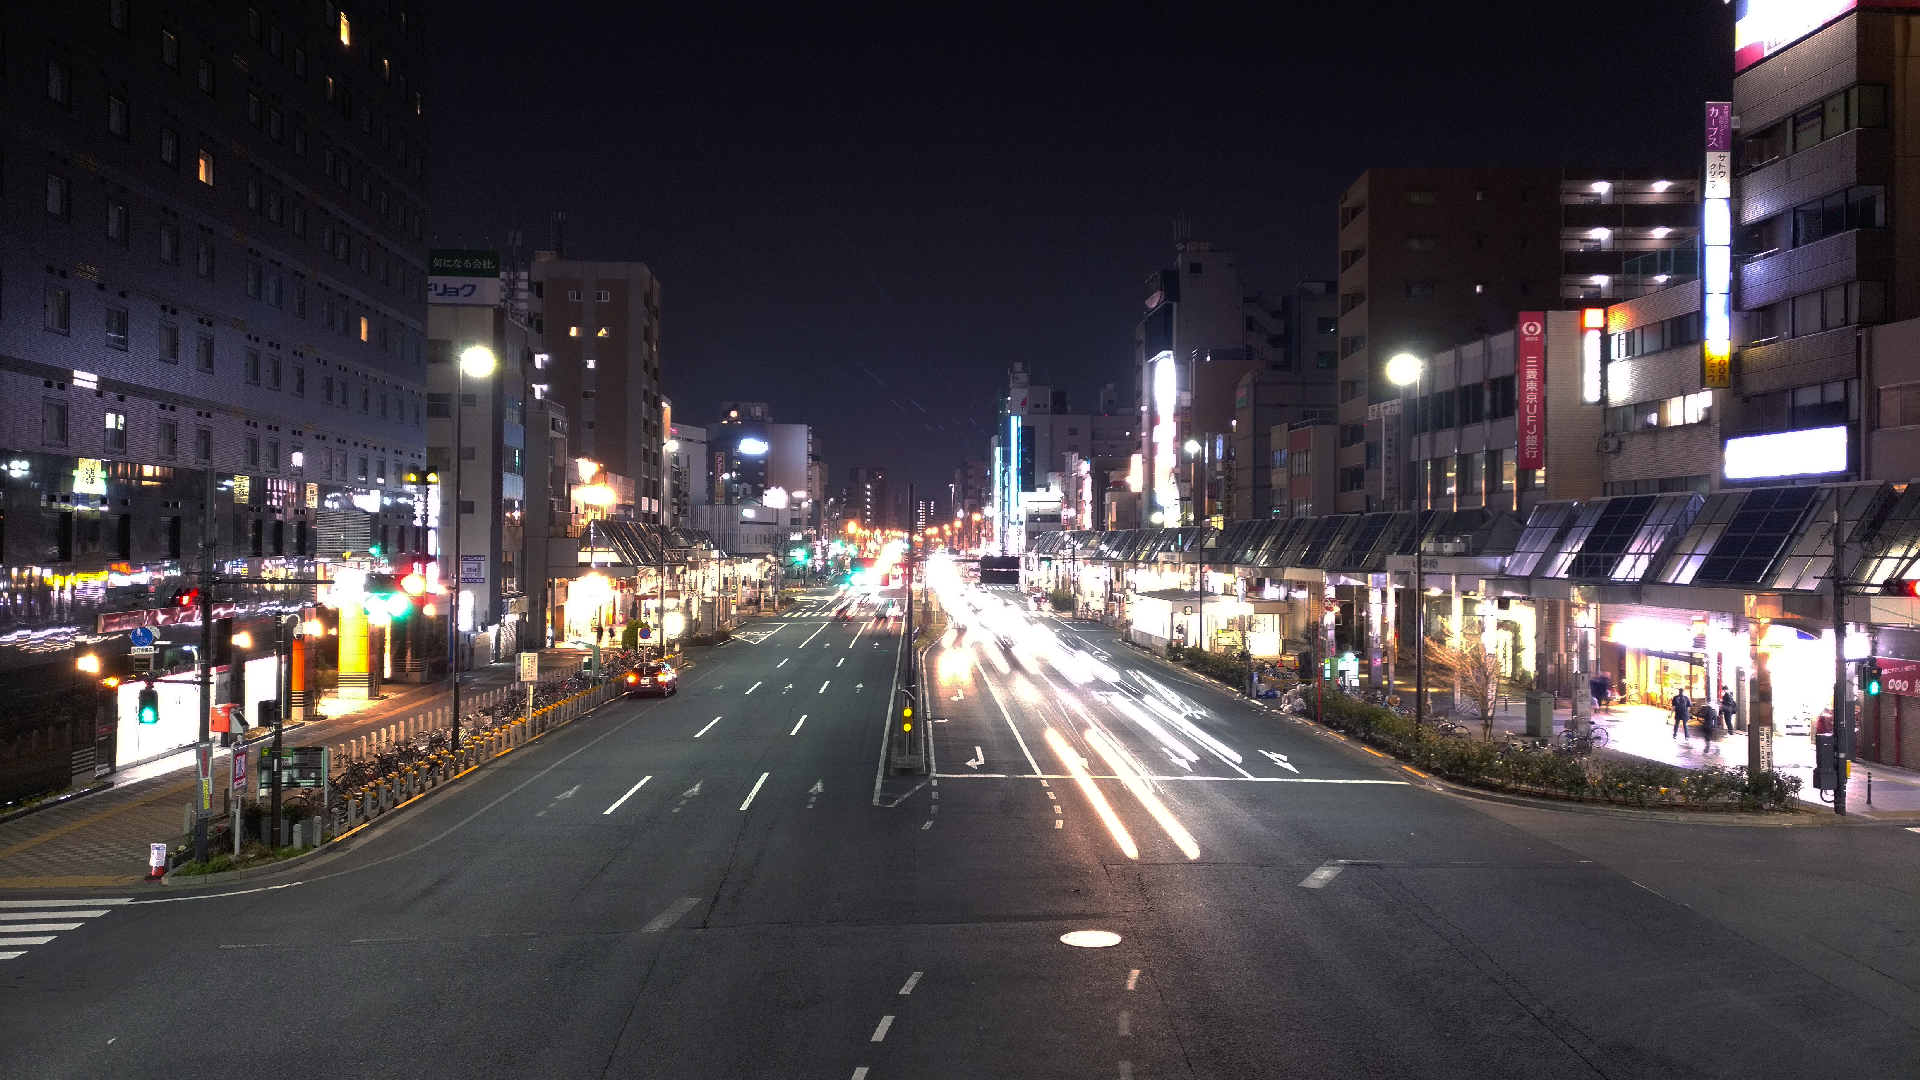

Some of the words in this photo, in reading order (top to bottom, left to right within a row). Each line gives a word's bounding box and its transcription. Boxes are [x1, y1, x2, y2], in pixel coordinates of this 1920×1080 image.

[1718, 154, 1726, 179] サトウ
[432, 258, 496, 270] 気になる会社。
[1525, 356, 1538, 458] 三菱東京UFJ銀行
